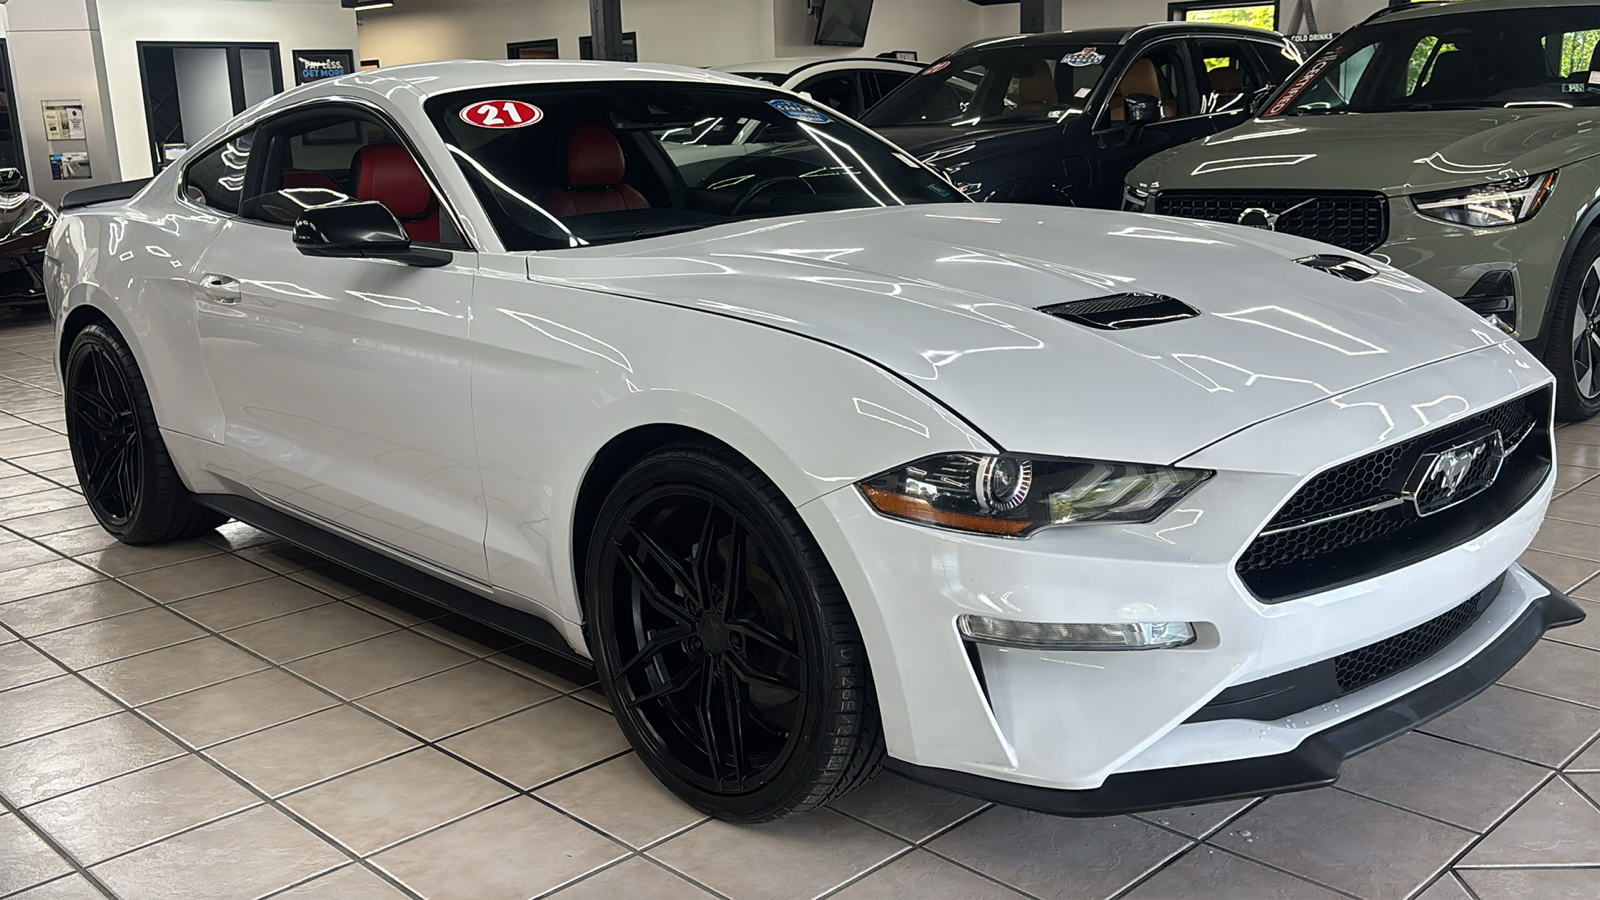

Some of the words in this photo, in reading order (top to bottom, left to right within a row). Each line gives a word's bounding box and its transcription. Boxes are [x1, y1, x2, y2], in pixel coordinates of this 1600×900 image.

[1309, 33, 1333, 41] DRINKS
[302, 69, 319, 77] GET
[320, 69, 345, 77] MORE
[1270, 61, 1327, 113] CERTIFIED
[477, 102, 522, 126] 21
